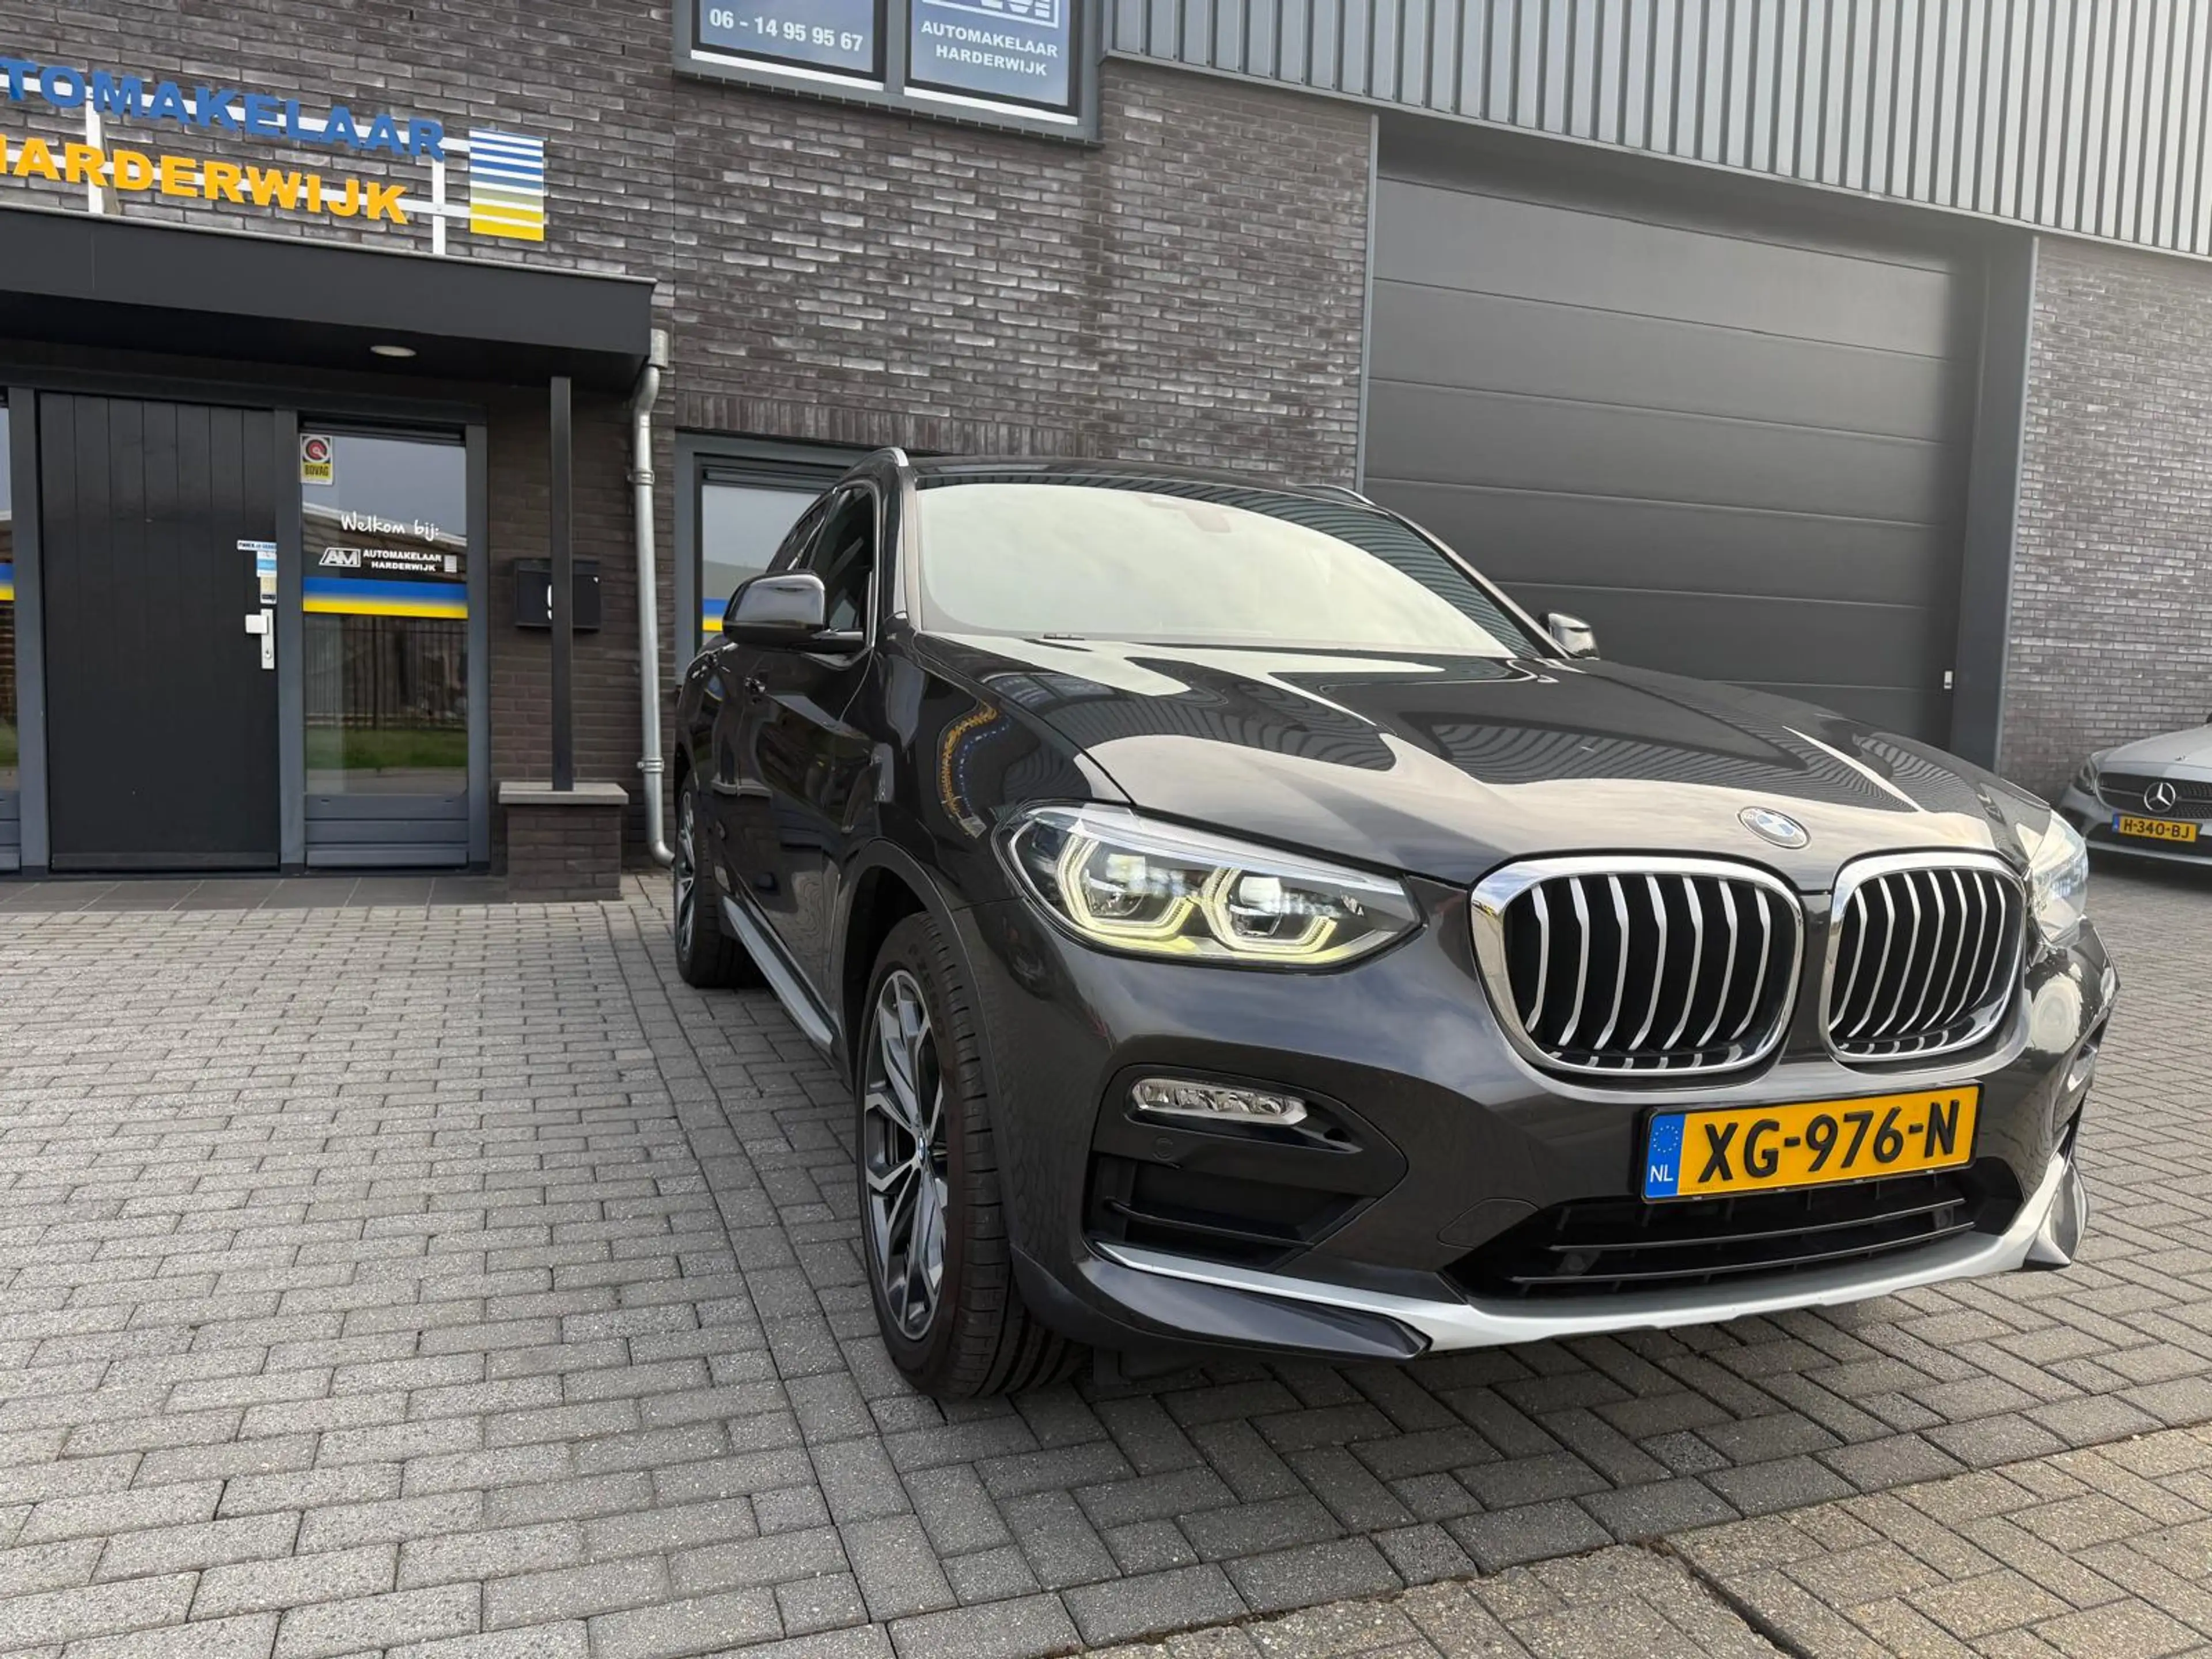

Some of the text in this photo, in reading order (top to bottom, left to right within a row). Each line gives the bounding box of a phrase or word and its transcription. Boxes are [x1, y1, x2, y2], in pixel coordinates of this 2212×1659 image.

[709, 9, 734, 29] 06
[753, 16, 778, 37] 14
[783, 21, 806, 41] 95
[811, 26, 835, 47] 95
[840, 32, 863, 51] 67
[921, 21, 1059, 58] AUTOMAKELAAR
[935, 44, 1047, 76] HARDERWIJK
[340, 510, 440, 541] Welkom bij:
[363, 549, 442, 562] AUTOMAKELAAR
[371, 561, 436, 572] HARDERWIJK
[2123, 818, 2190, 839] H-340-BJ
[1698, 1099, 1960, 1183] XG-976-N
[1650, 1164, 1674, 1183] NL
